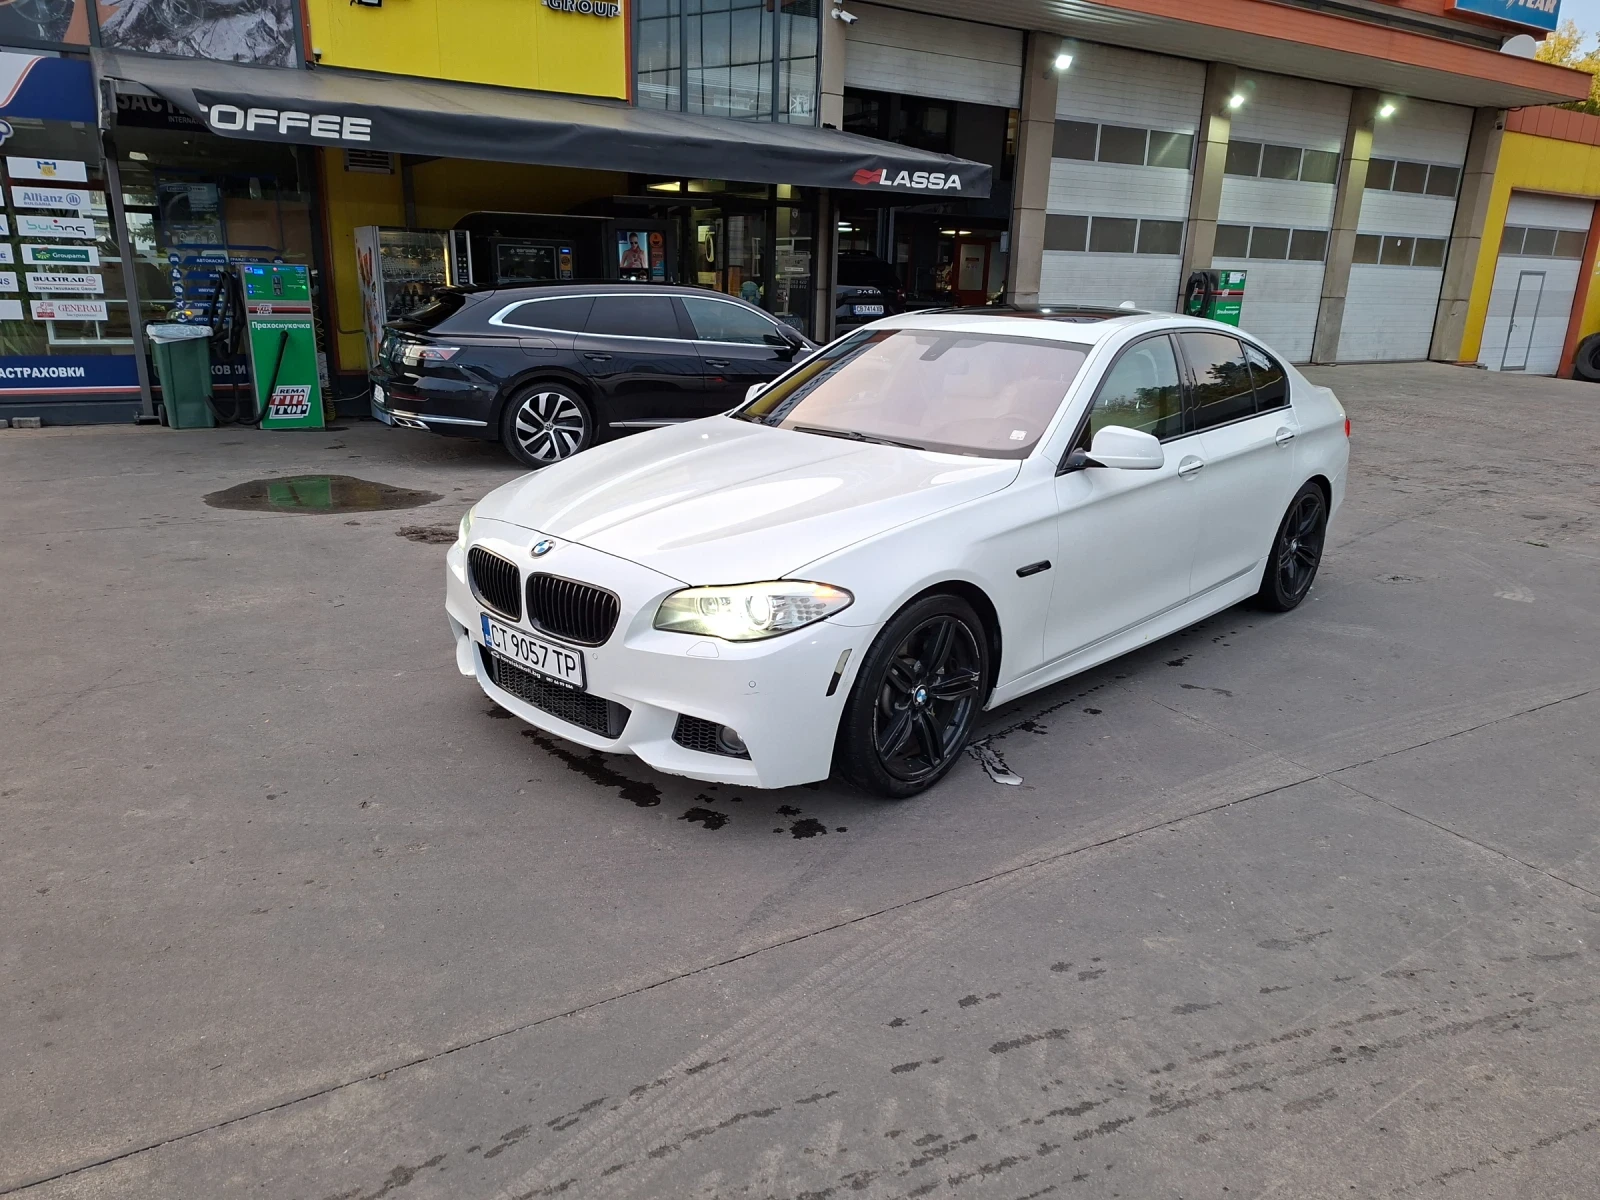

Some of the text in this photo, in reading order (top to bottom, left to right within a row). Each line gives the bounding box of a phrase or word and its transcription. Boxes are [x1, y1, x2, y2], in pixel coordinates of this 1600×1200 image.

[548, 0, 619, 17] GROUP
[198, 104, 371, 141] OFFEE
[879, 169, 962, 190] LASSA
[23, 192, 63, 203] Allianz
[52, 252, 86, 260] Groupama
[58, 304, 103, 313] GENERALI
[252, 321, 310, 330] Прахосмукачка
[272, 395, 304, 404] TIP
[277, 405, 307, 414] TOP
[491, 624, 576, 678] CT 9057 TP
